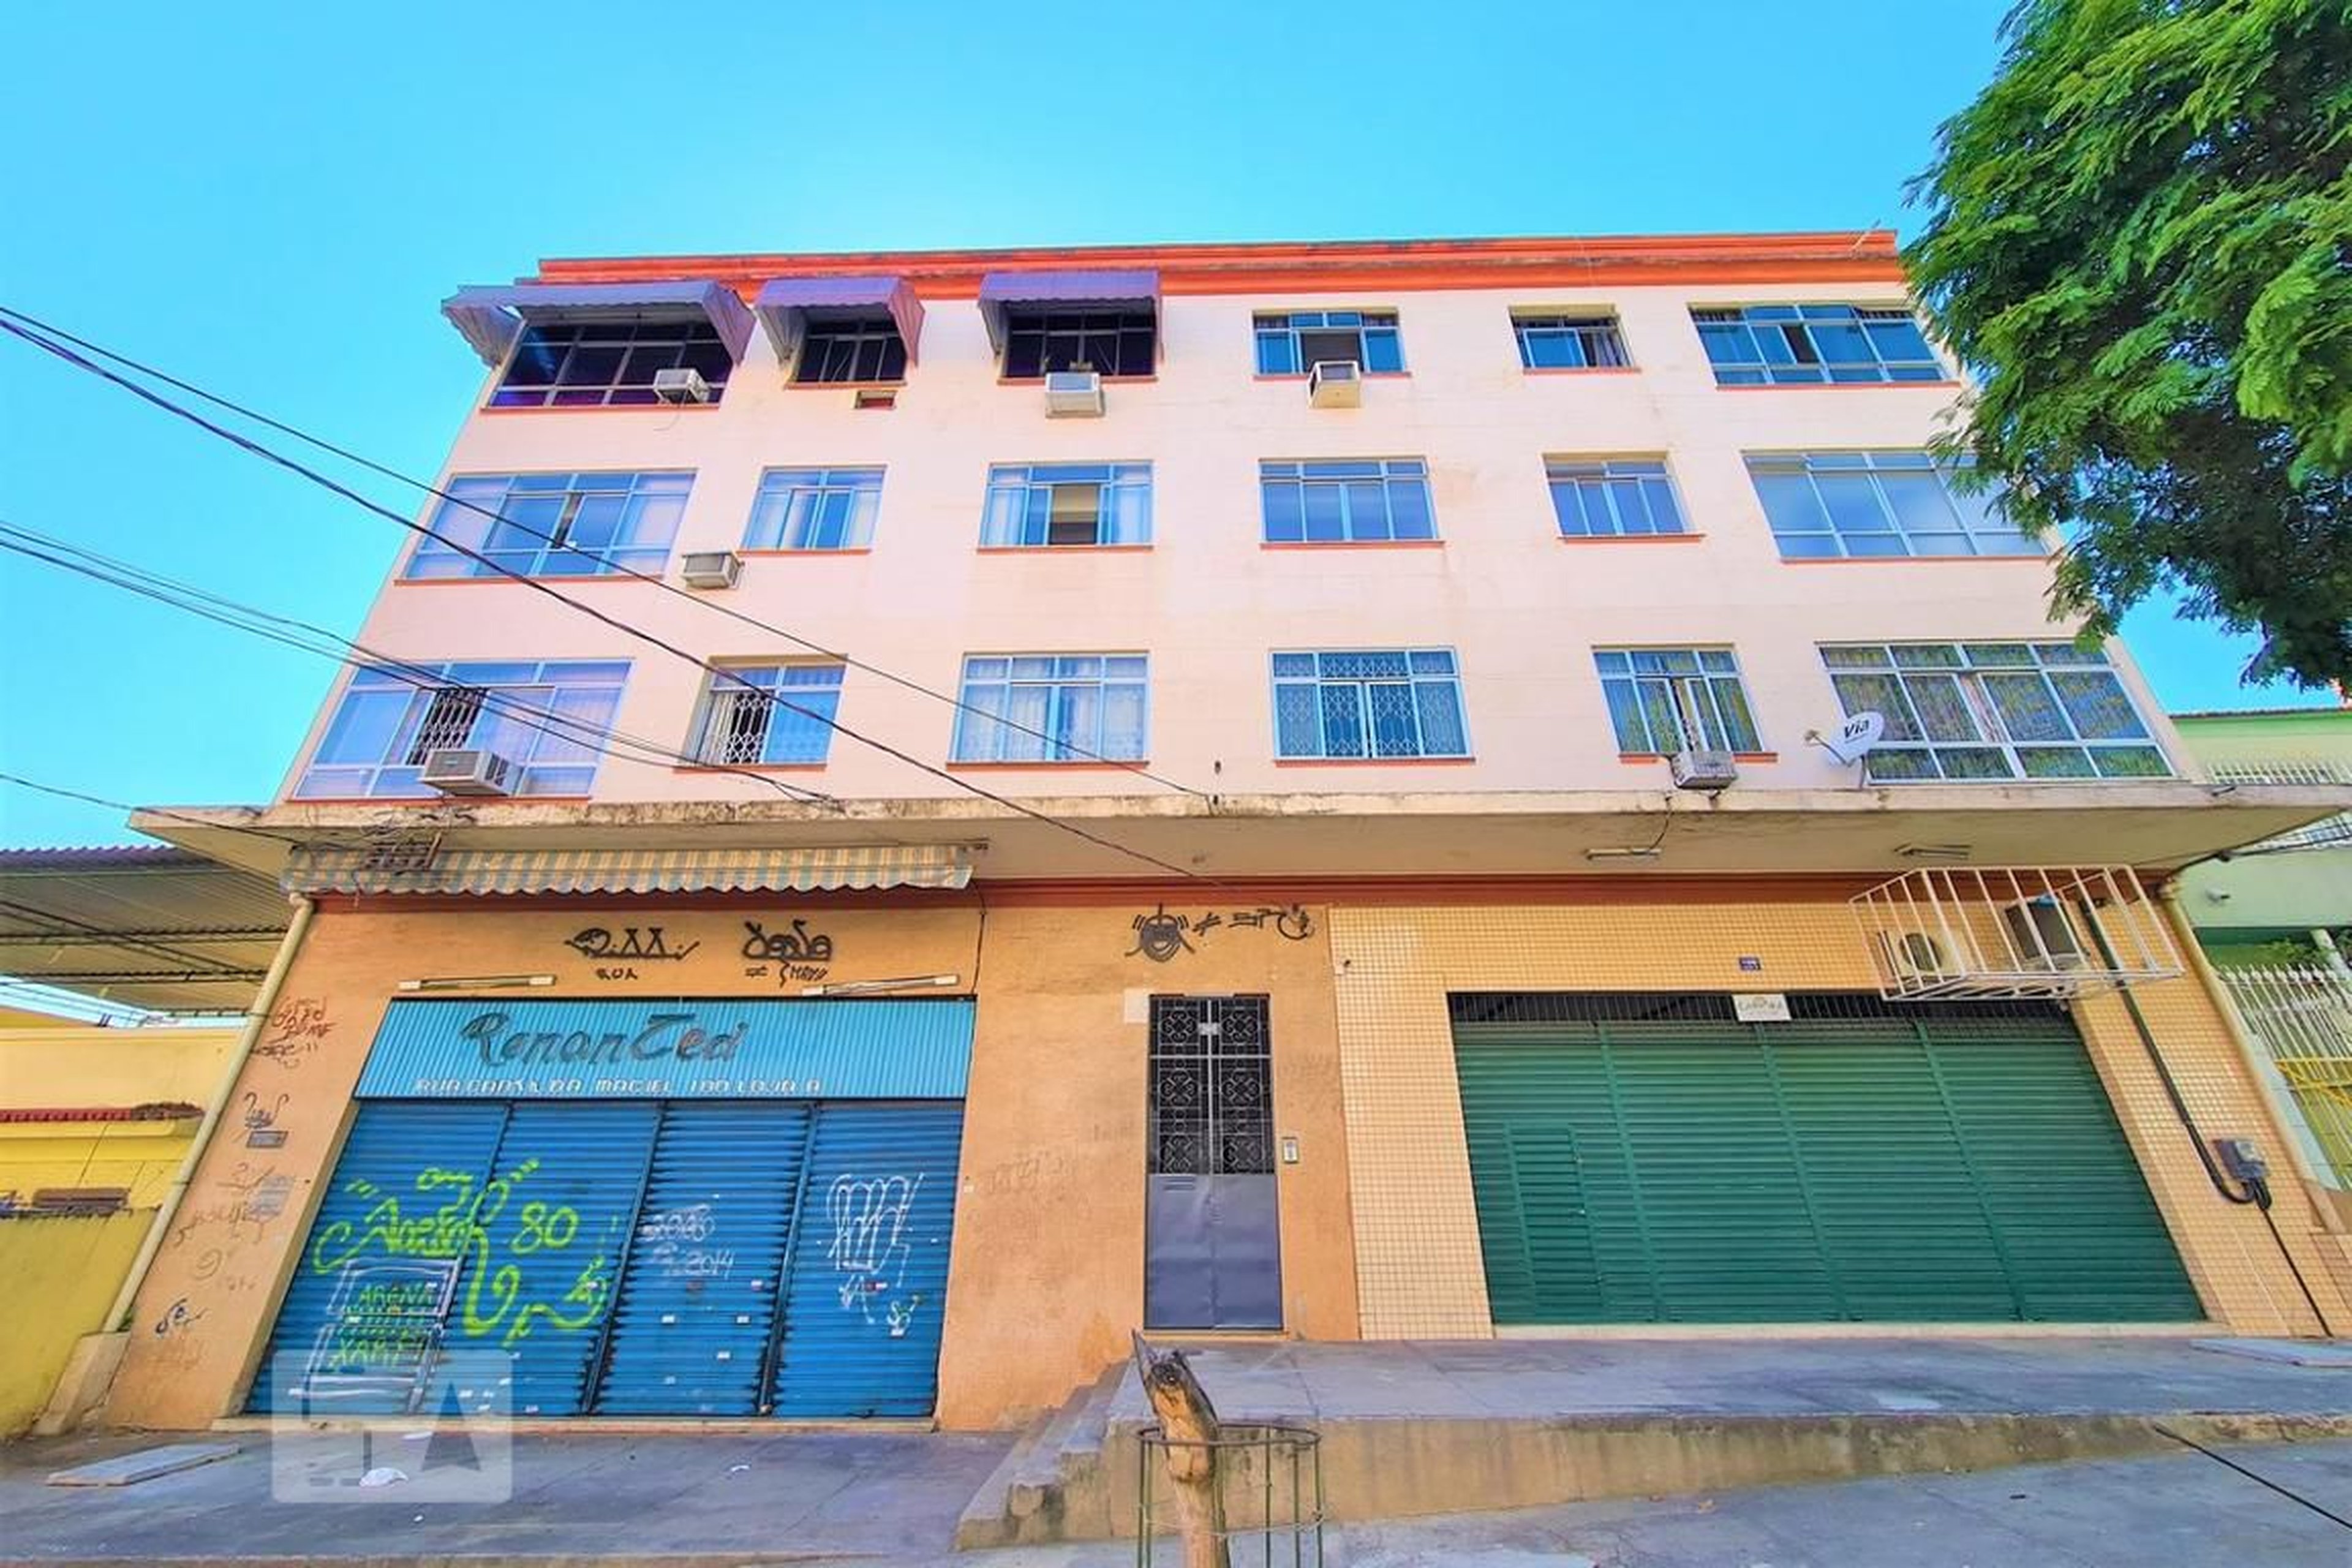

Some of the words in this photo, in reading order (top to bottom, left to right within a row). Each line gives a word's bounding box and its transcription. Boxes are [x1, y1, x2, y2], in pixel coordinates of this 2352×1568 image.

[1844, 719, 1870, 739] Via
[417, 1077, 461, 1095] RUA
[510, 1200, 579, 1254] 80
